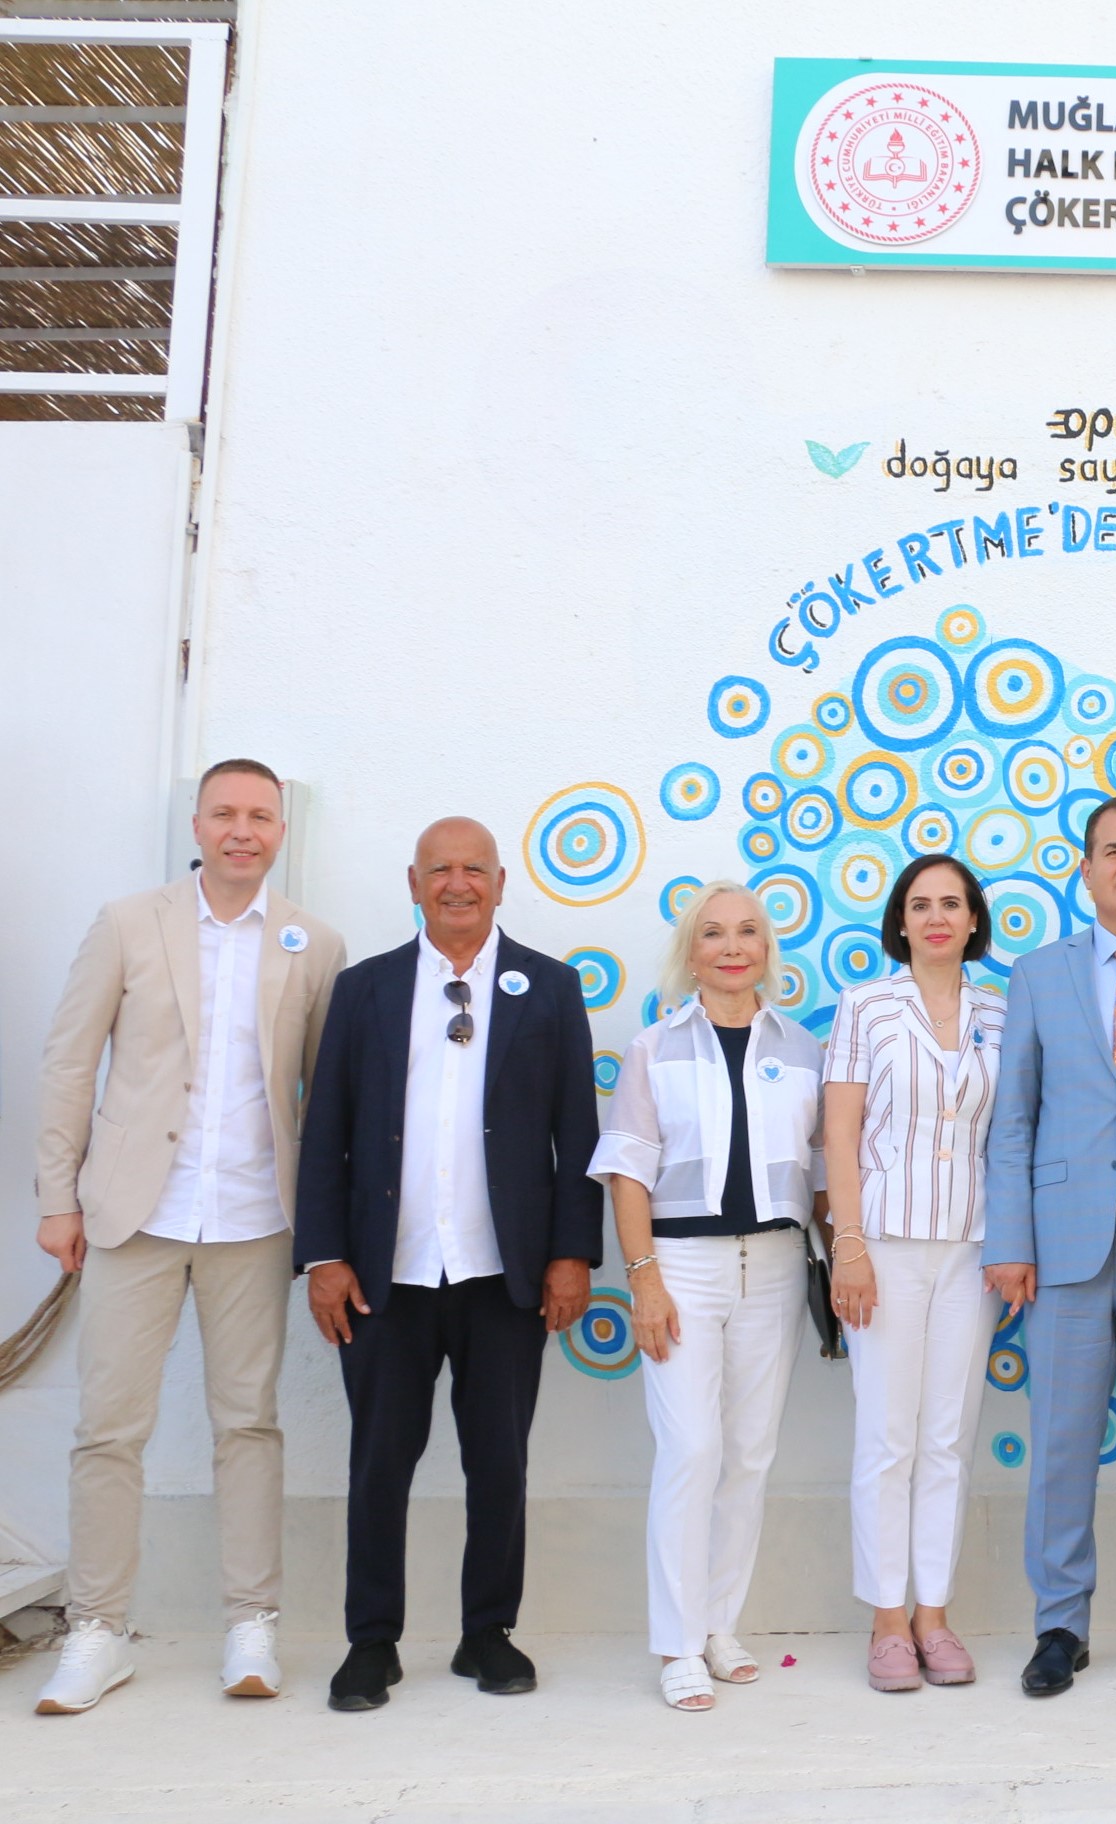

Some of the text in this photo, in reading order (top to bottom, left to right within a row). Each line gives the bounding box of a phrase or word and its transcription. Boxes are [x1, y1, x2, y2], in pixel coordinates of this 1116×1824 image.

[842, 111, 890, 172] CUMHURİYETİ
[925, 124, 949, 159] EĞİTİM
[1007, 148, 1104, 180] HALK
[845, 175, 884, 210] TÜRKİYE
[906, 162, 949, 210] BAKANLIĞI
[884, 438, 1018, 493] doğaya
